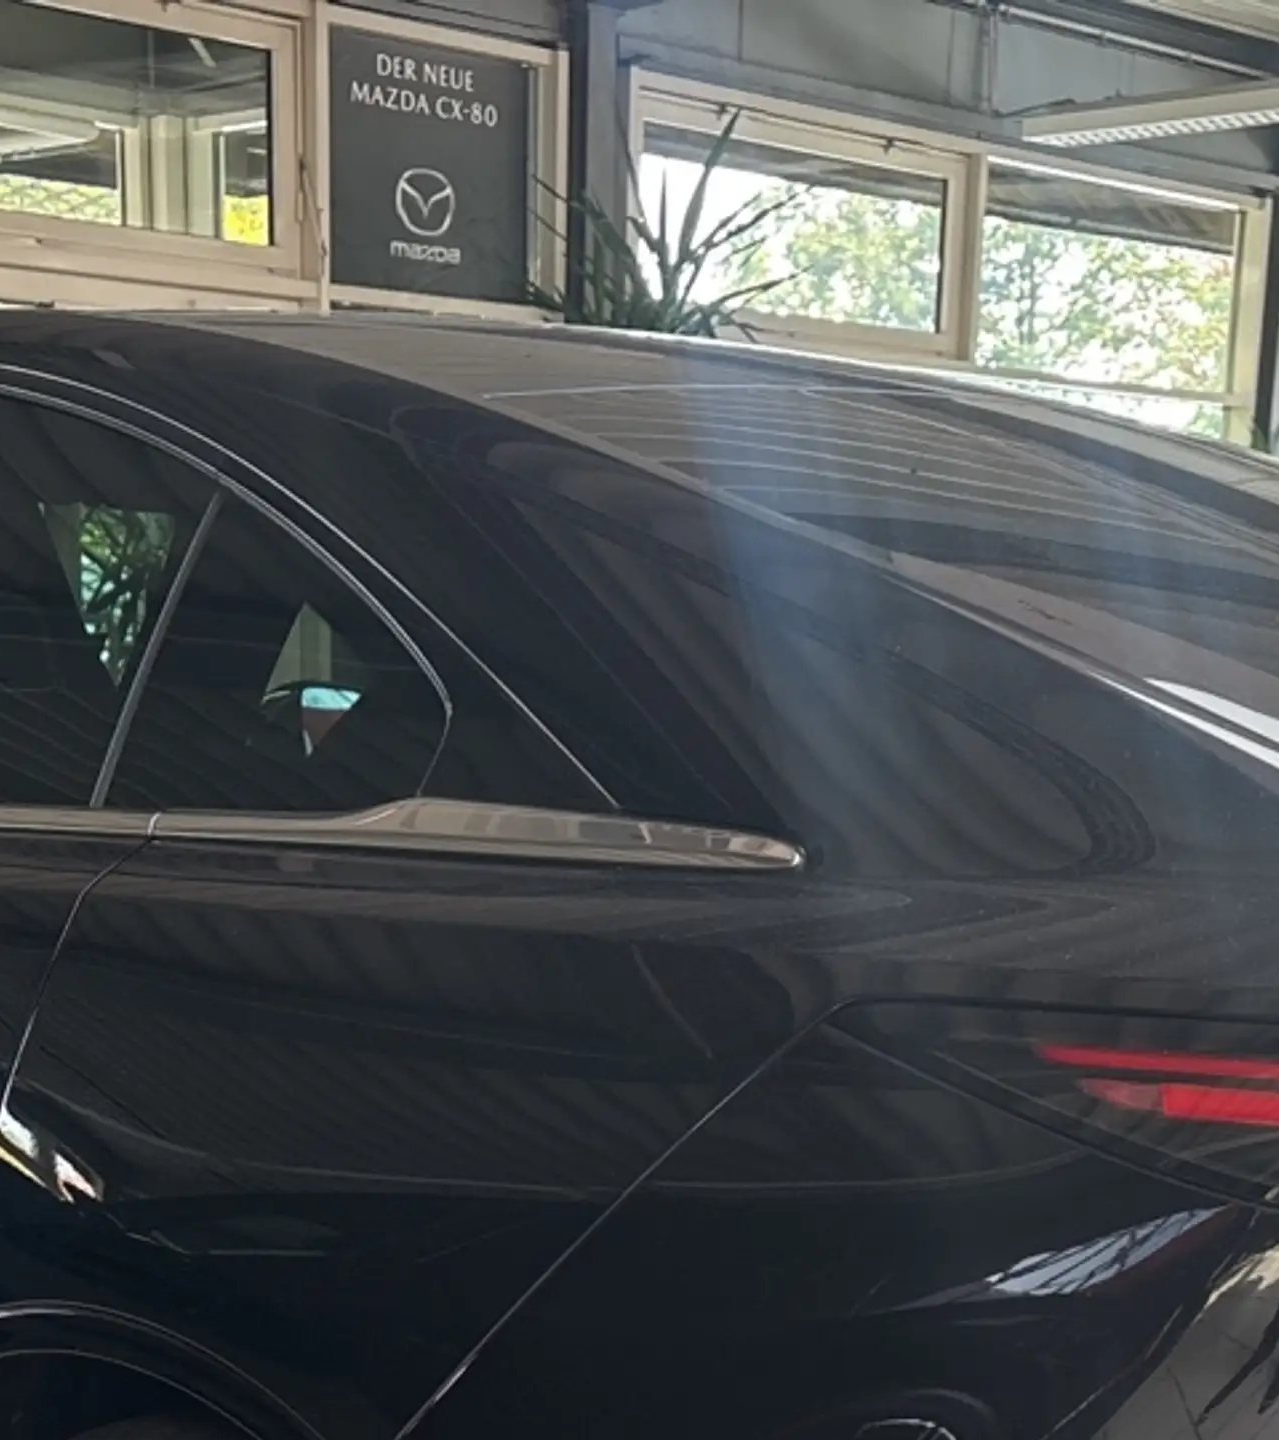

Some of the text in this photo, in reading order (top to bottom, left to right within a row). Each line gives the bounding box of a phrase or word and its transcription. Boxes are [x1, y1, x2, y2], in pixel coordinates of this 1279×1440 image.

[376, 53, 474, 92] DER NEUE
[350, 80, 499, 127] MAZDA CX-80
[390, 240, 461, 265] mazda
